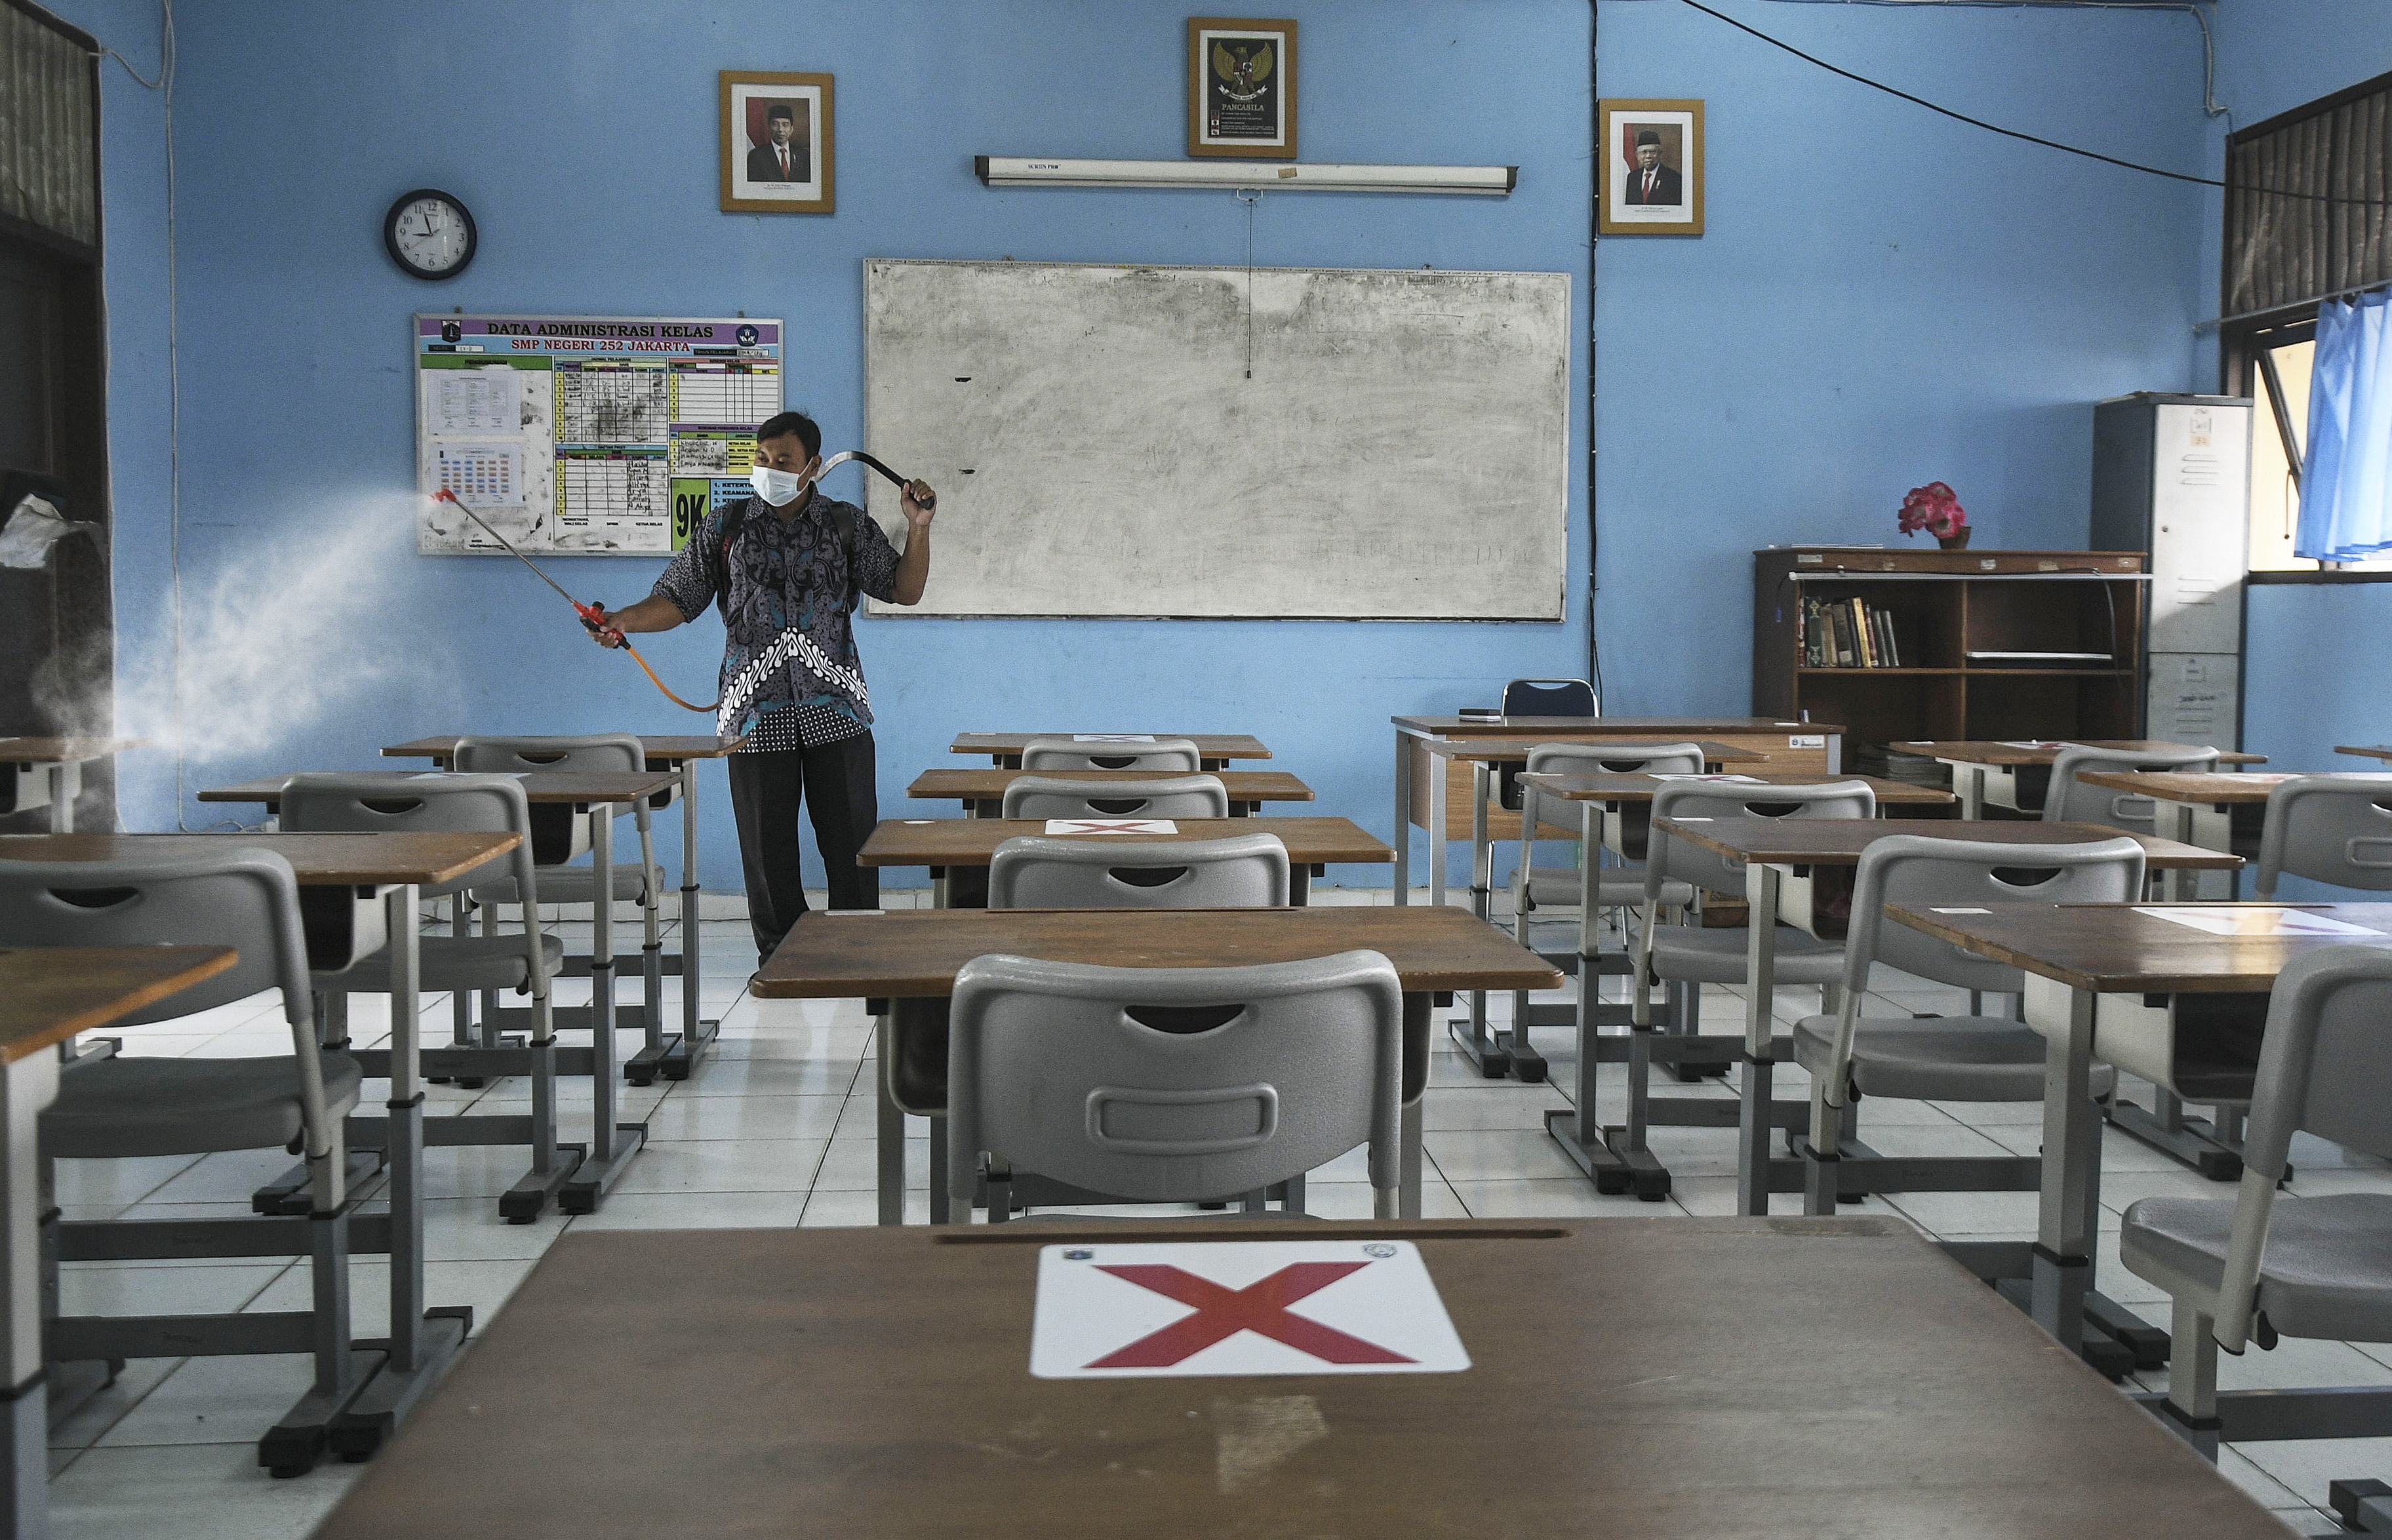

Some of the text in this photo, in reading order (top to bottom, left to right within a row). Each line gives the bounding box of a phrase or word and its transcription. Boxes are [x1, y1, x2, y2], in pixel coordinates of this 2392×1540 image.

[1222, 103, 1265, 111] PANCASILA
[414, 205, 422, 214] 11
[428, 203, 437, 211] 12
[445, 207, 448, 216] 1
[403, 216, 412, 224] 10
[455, 218, 460, 227] 2
[458, 233, 465, 242] 3
[414, 253, 420, 262] 7
[443, 256, 448, 265] 5
[428, 258, 435, 267] 6
[487, 323, 713, 338] DATA ADMINISTRASI KELAS
[511, 339, 690, 352] SMP NEGERI 252 JAKARTA
[676, 494, 706, 537] 9K
